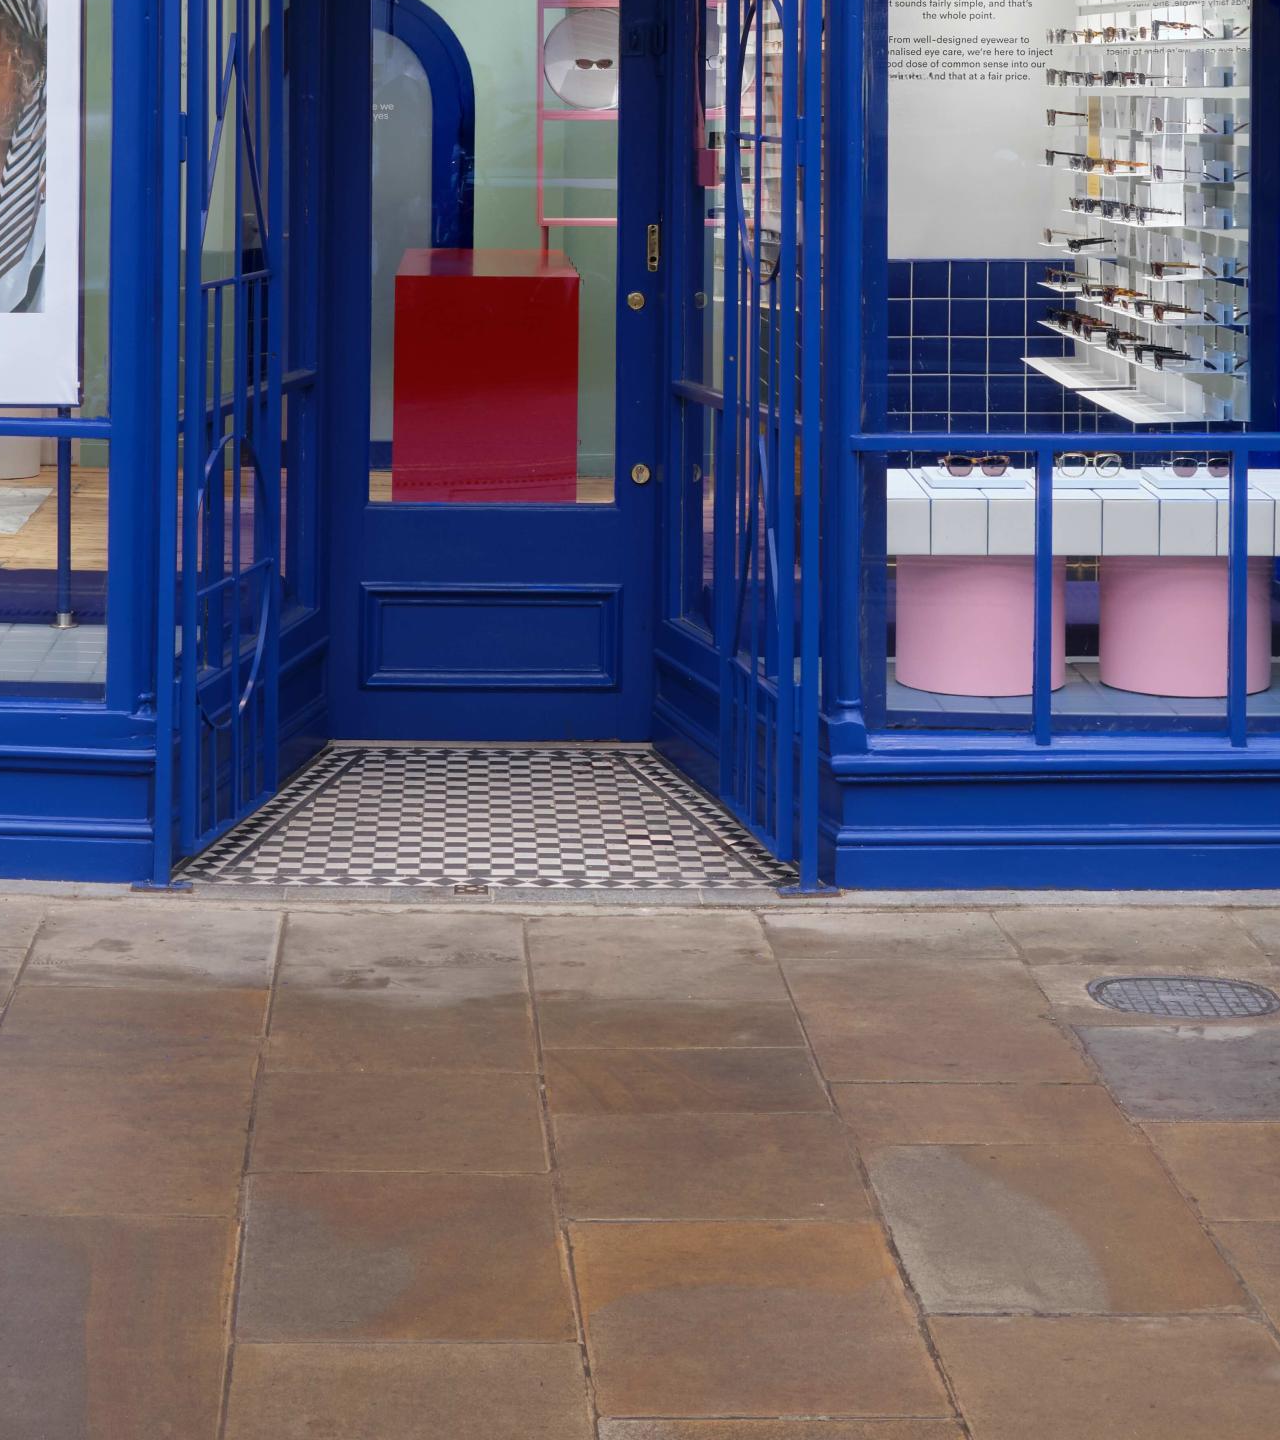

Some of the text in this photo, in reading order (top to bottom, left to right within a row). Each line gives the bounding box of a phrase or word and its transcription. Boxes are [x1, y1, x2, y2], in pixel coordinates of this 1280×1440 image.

[929, 0, 951, 9] fairly
[954, 0, 986, 9] simple,
[970, 12, 996, 21] point.
[888, 36, 911, 44] From
[913, 36, 978, 46] well-designed
[980, 37, 1018, 46] eyewear
[924, 50, 940, 58] eye
[943, 49, 965, 57] care,
[994, 48, 1014, 56] here
[1028, 48, 1053, 58] inject
[906, 60, 928, 68] dose
[930, 60, 939, 68] of
[1011, 60, 1028, 68] into
[949, 72, 966, 80] that
[988, 72, 1002, 80] fair
[1005, 72, 1030, 82] price.
[373, 113, 389, 121] yes
